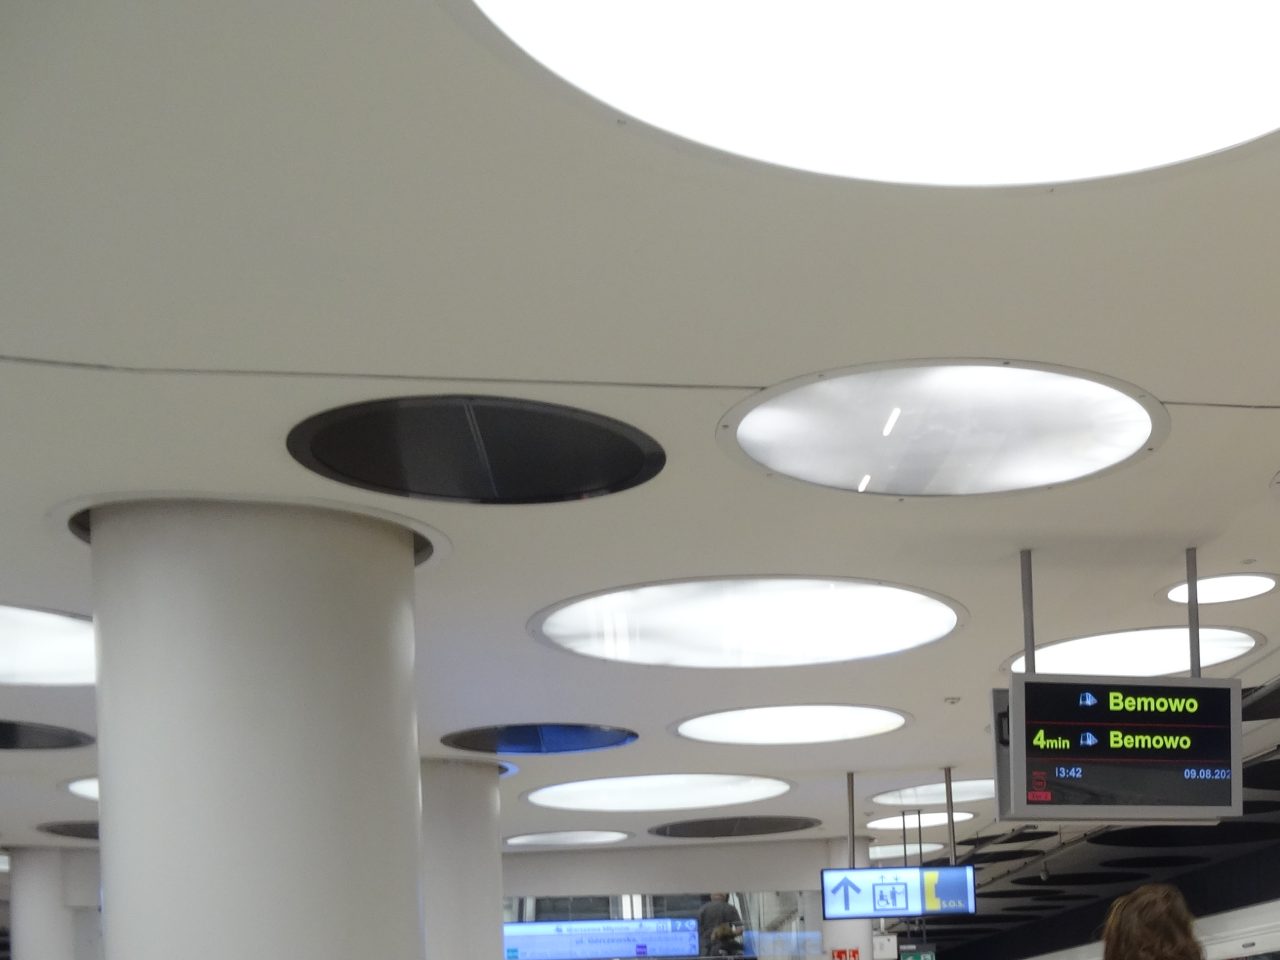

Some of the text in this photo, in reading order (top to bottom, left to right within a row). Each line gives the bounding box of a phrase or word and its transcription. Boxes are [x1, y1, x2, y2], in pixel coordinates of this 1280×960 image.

[1108, 692, 1199, 713] Bemowo
[1109, 731, 1192, 750] Bemowo
[1055, 767, 1083, 778] 13:42
